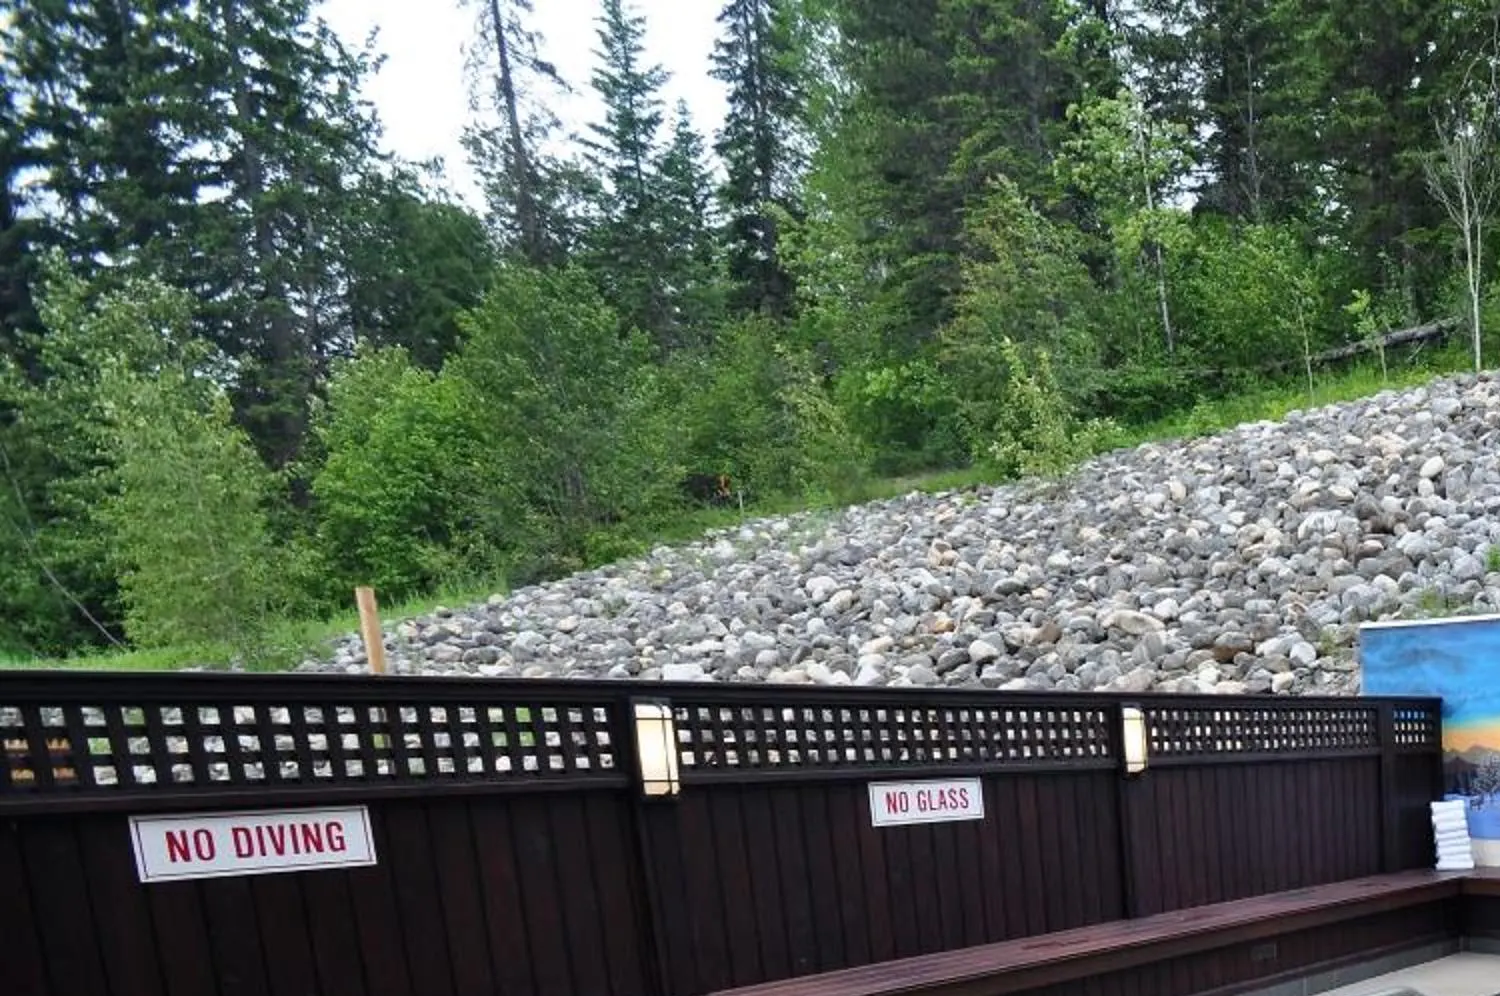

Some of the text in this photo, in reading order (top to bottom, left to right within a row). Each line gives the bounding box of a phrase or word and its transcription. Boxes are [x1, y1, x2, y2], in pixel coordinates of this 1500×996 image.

[886, 788, 969, 814] NO GLASS
[165, 821, 347, 862] NO DIVING
